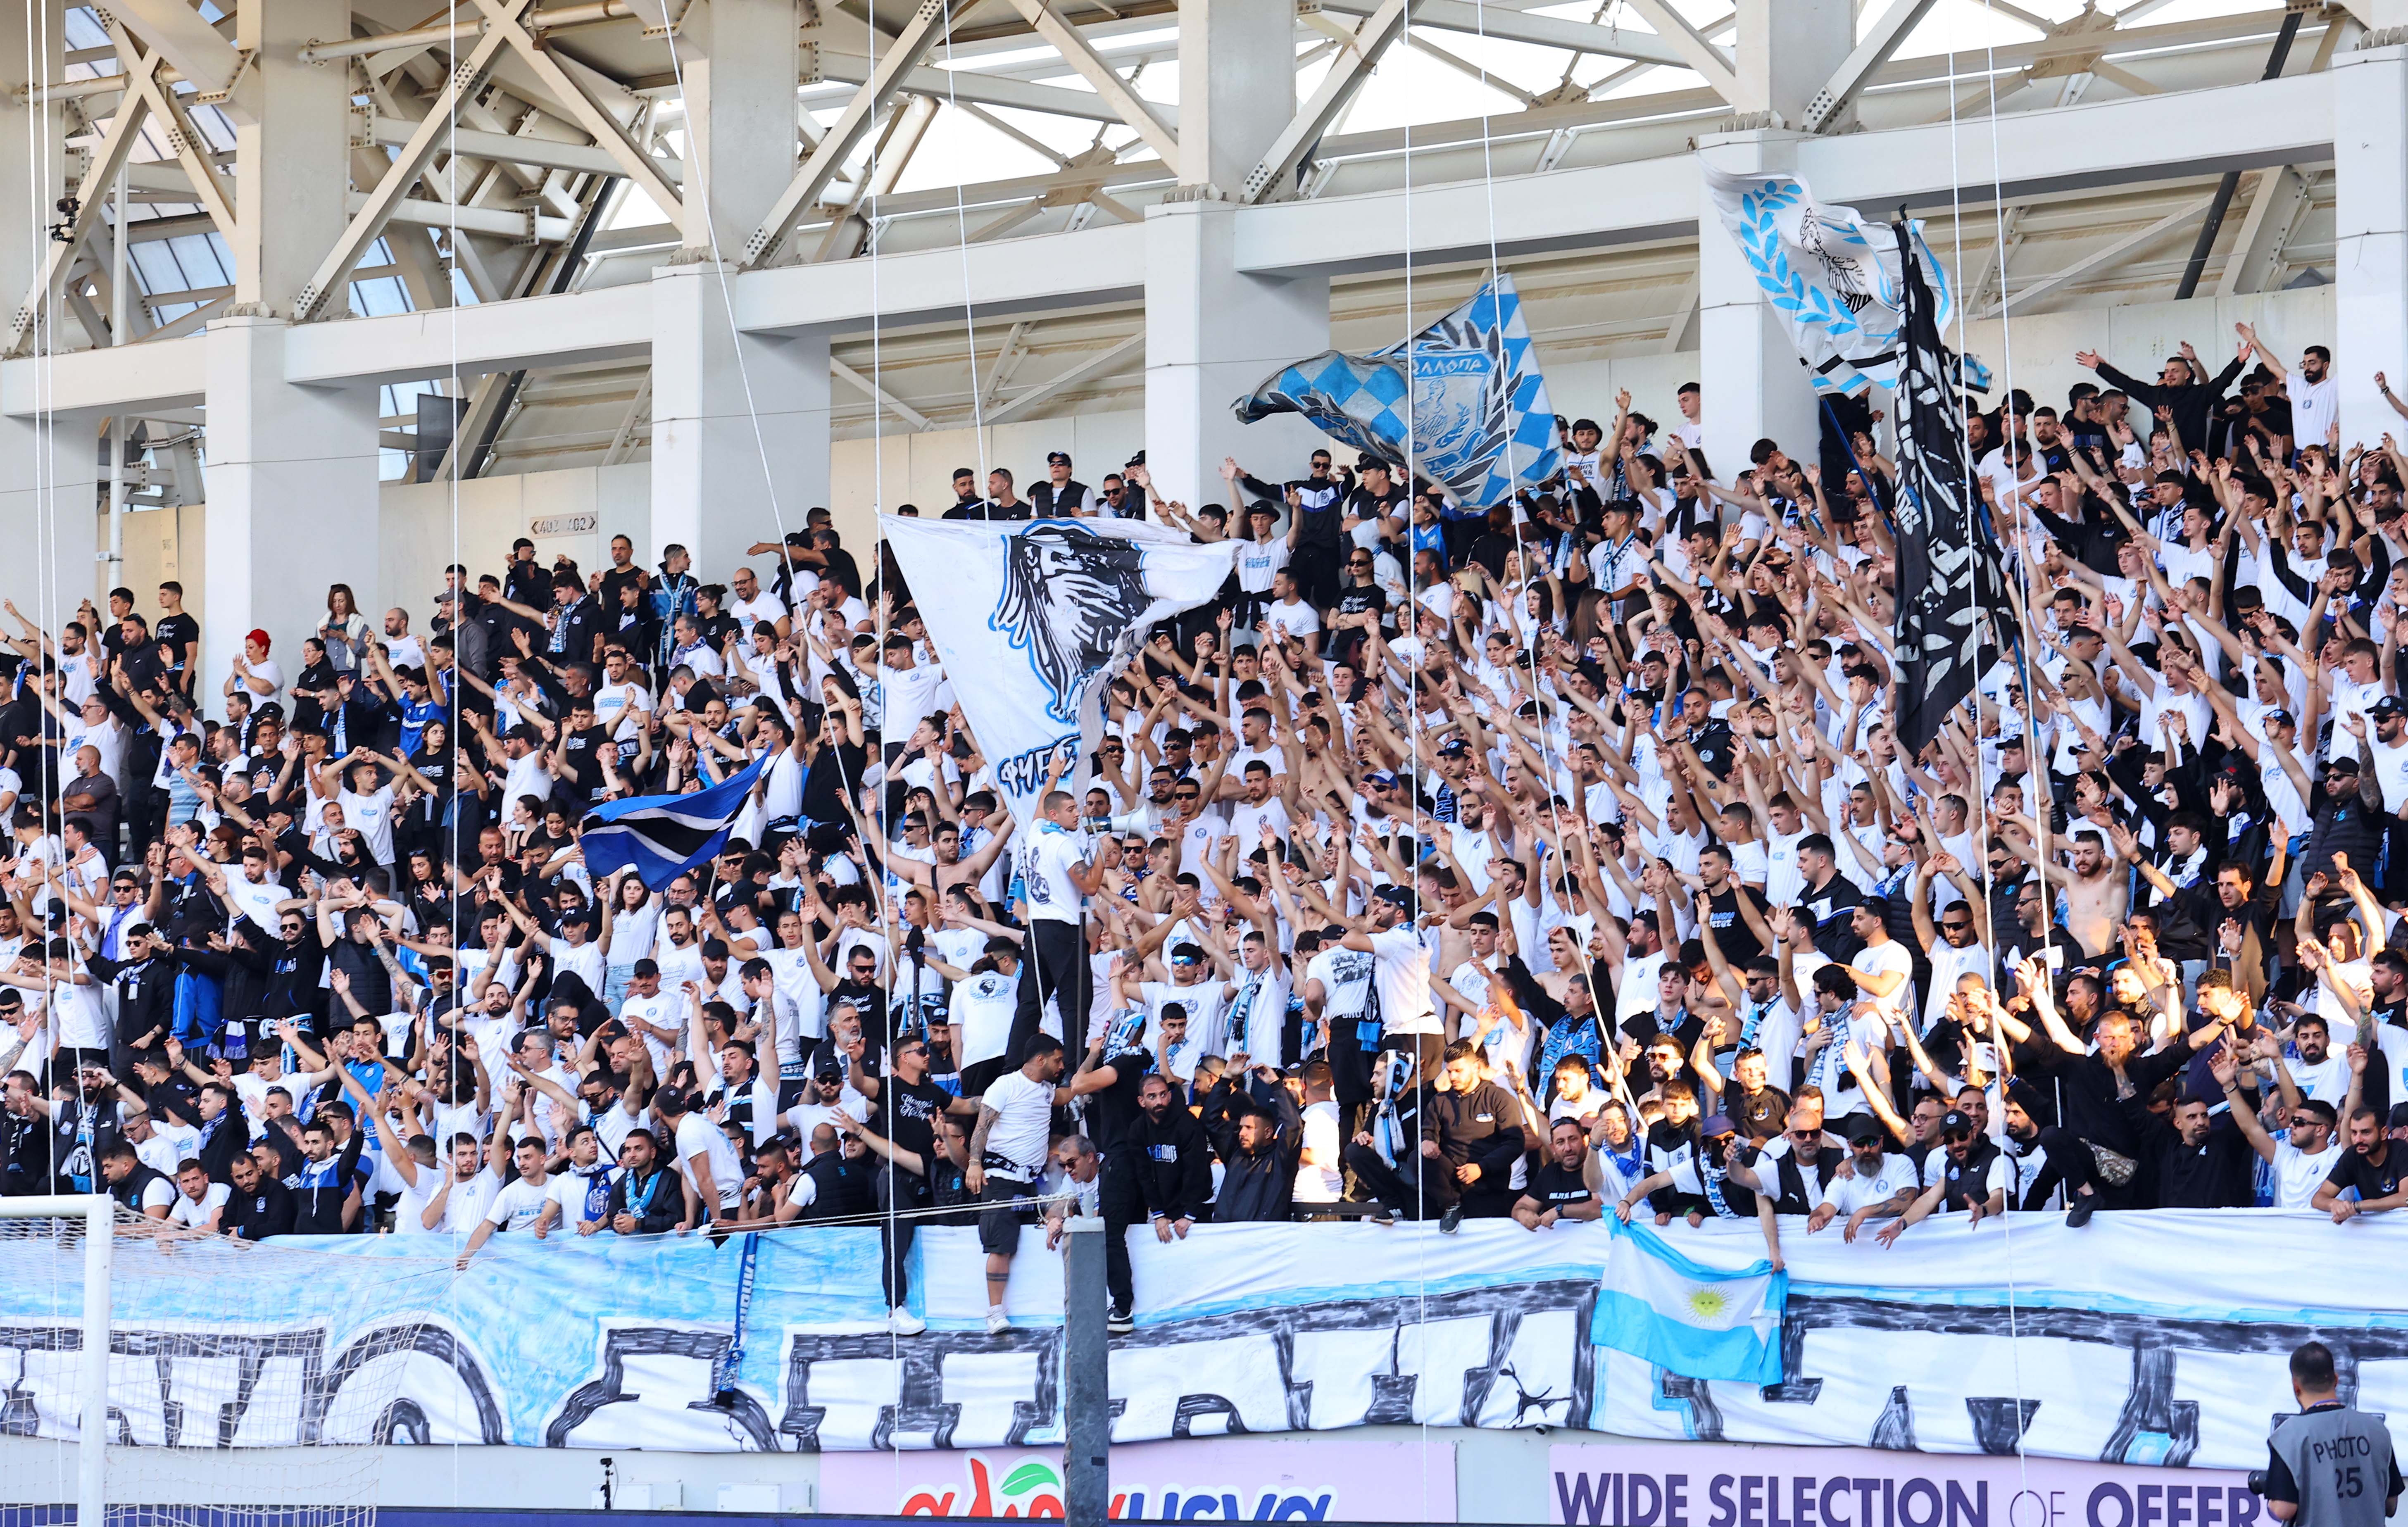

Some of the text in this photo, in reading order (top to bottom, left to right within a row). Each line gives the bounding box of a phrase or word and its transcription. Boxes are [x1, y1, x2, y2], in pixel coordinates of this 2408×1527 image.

[2313, 1435, 2370, 1463] PHOTO
[1555, 1472, 2282, 1527] WIDE SELECTION OF OFFER
